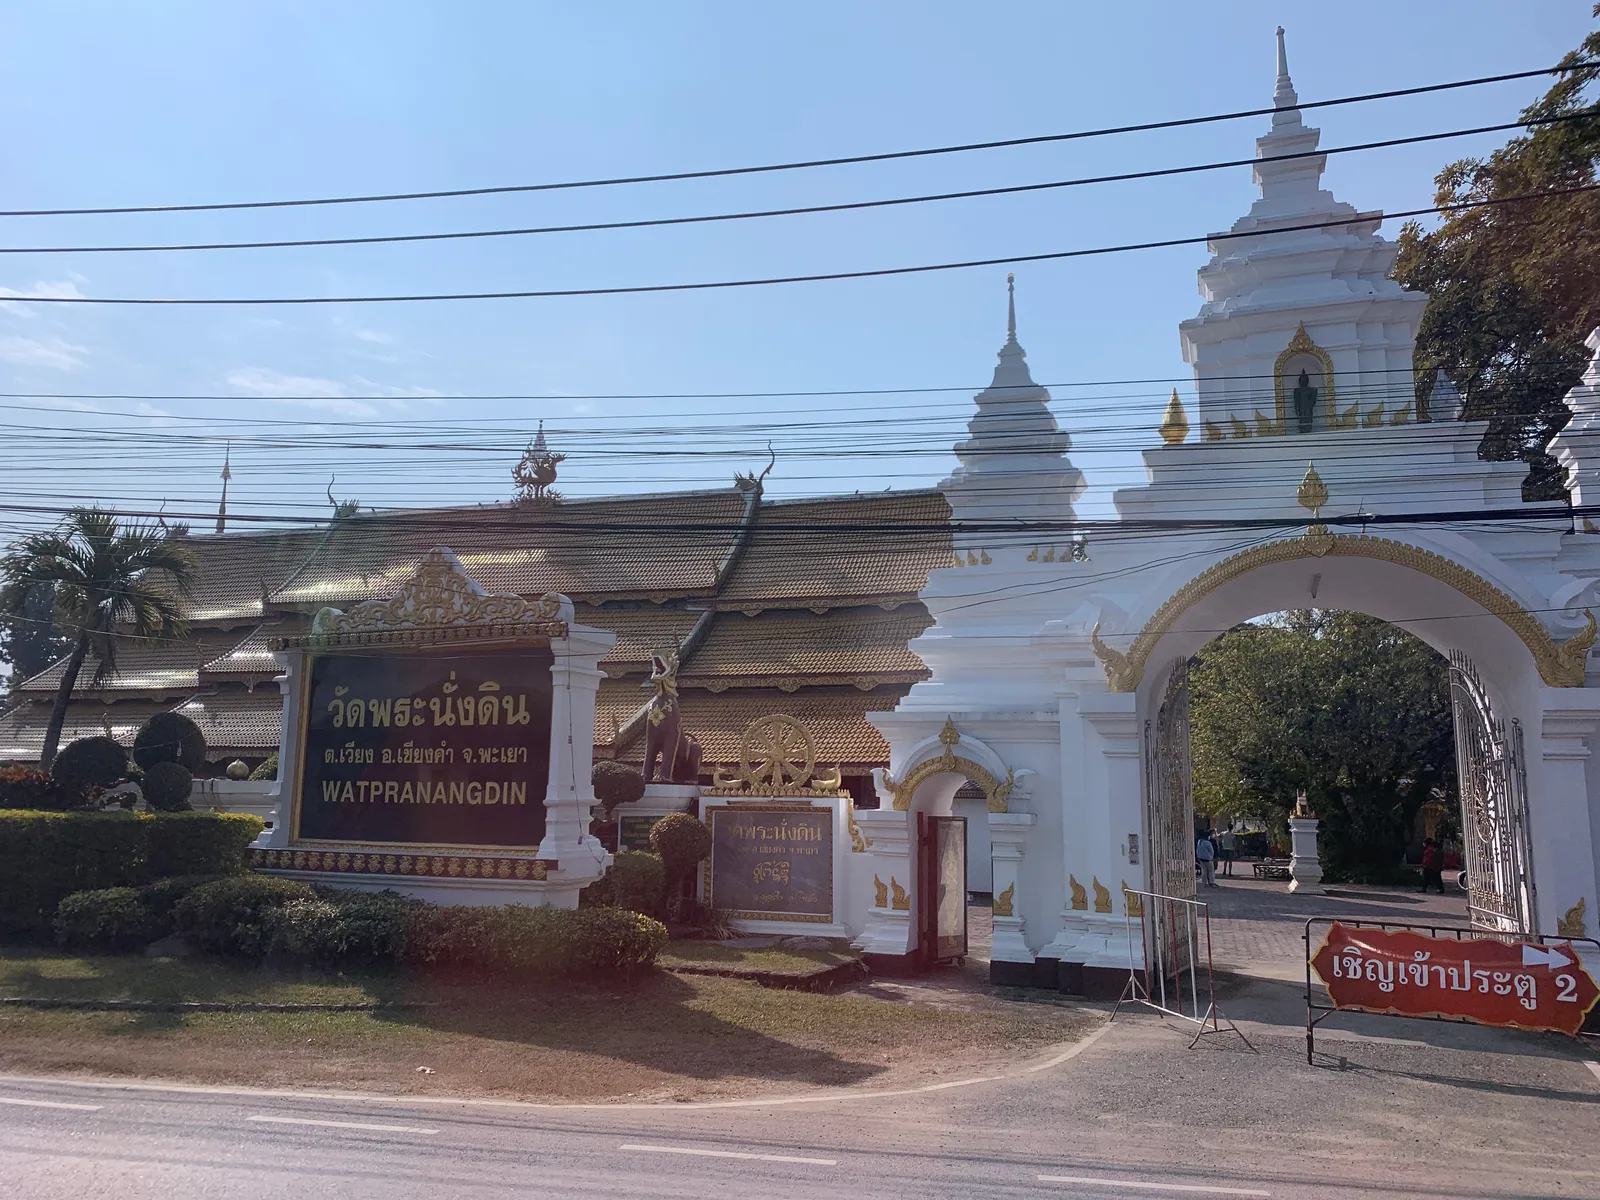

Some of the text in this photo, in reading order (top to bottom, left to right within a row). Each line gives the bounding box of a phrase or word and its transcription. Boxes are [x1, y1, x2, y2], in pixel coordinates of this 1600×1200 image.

[328, 671, 530, 728] วัดพระนั่งดิน
[325, 740, 527, 764] ต.เวียง อ.เชียงคำ จ.พะเยา
[322, 780, 526, 805] WATPRANANGDIN
[1333, 946, 1578, 1010] เชิญเข้าประตู 2
